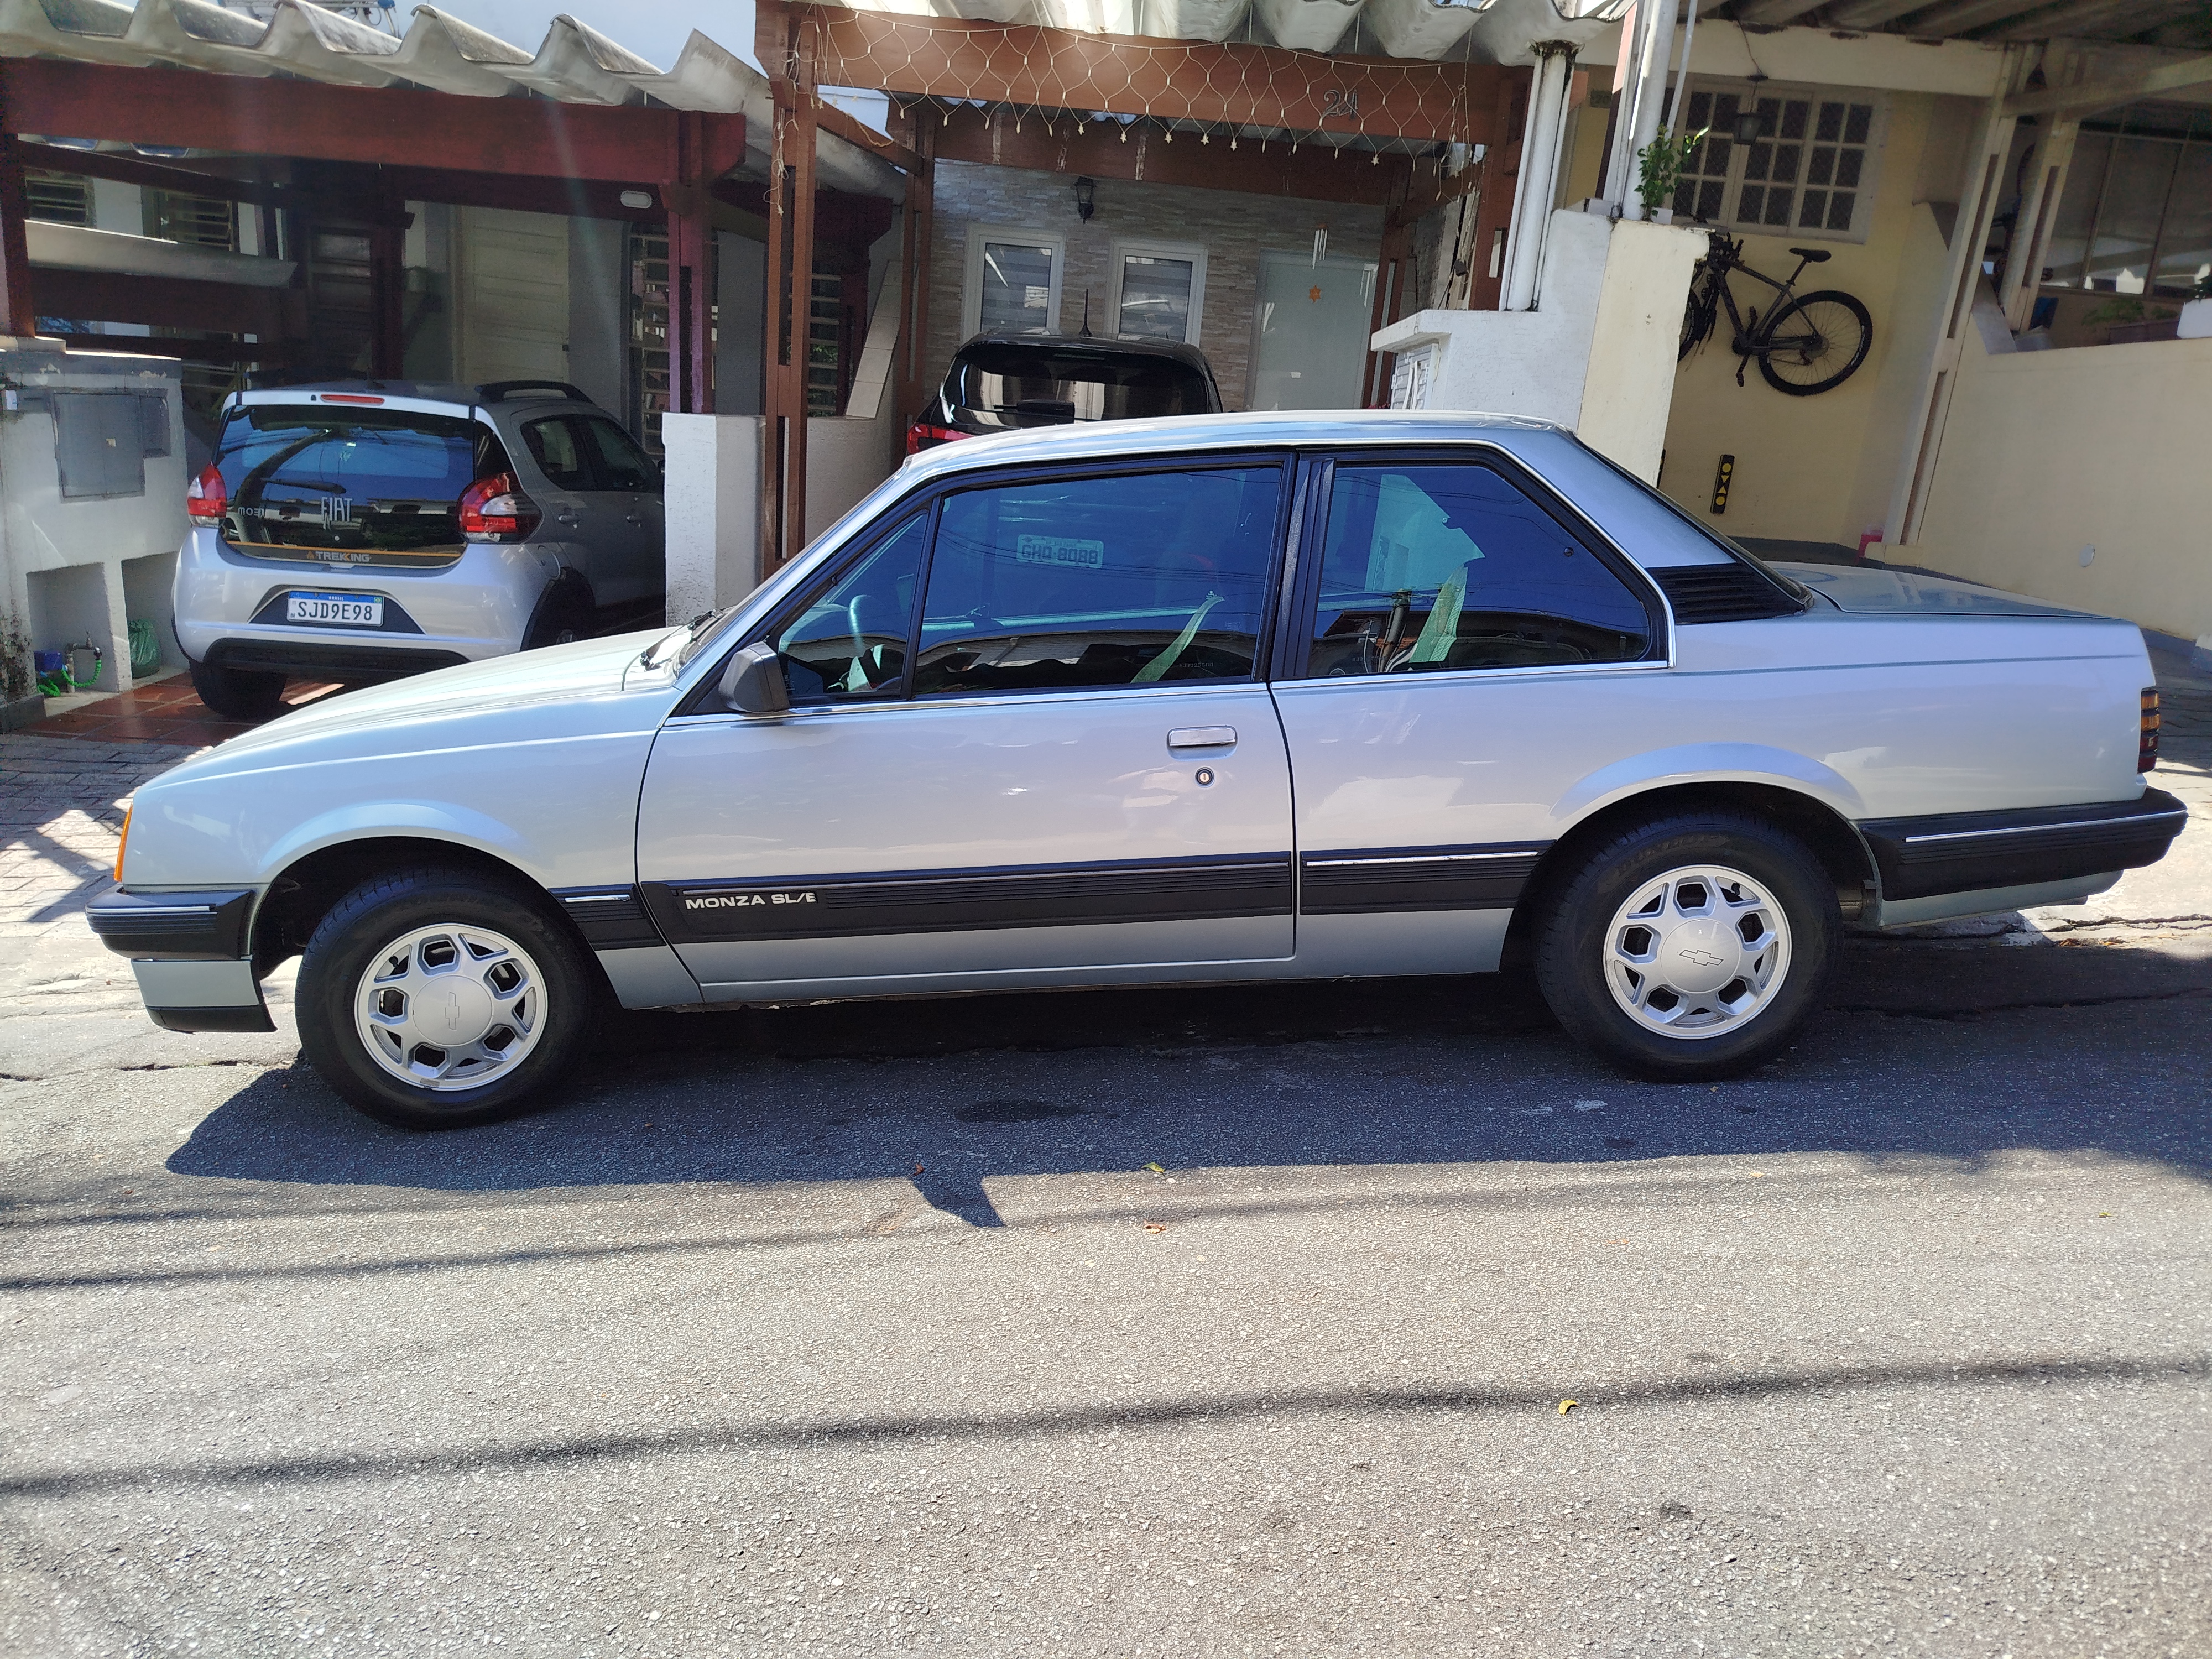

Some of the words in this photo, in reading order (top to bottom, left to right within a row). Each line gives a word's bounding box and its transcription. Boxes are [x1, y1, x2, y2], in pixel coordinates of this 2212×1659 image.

[1322, 89, 1358, 118] 24
[321, 497, 353, 522] FIAT
[315, 551, 369, 562] TREKKING
[298, 601, 372, 621] SJD9E98
[685, 895, 766, 910] MONZA
[771, 891, 817, 904] SL/E
